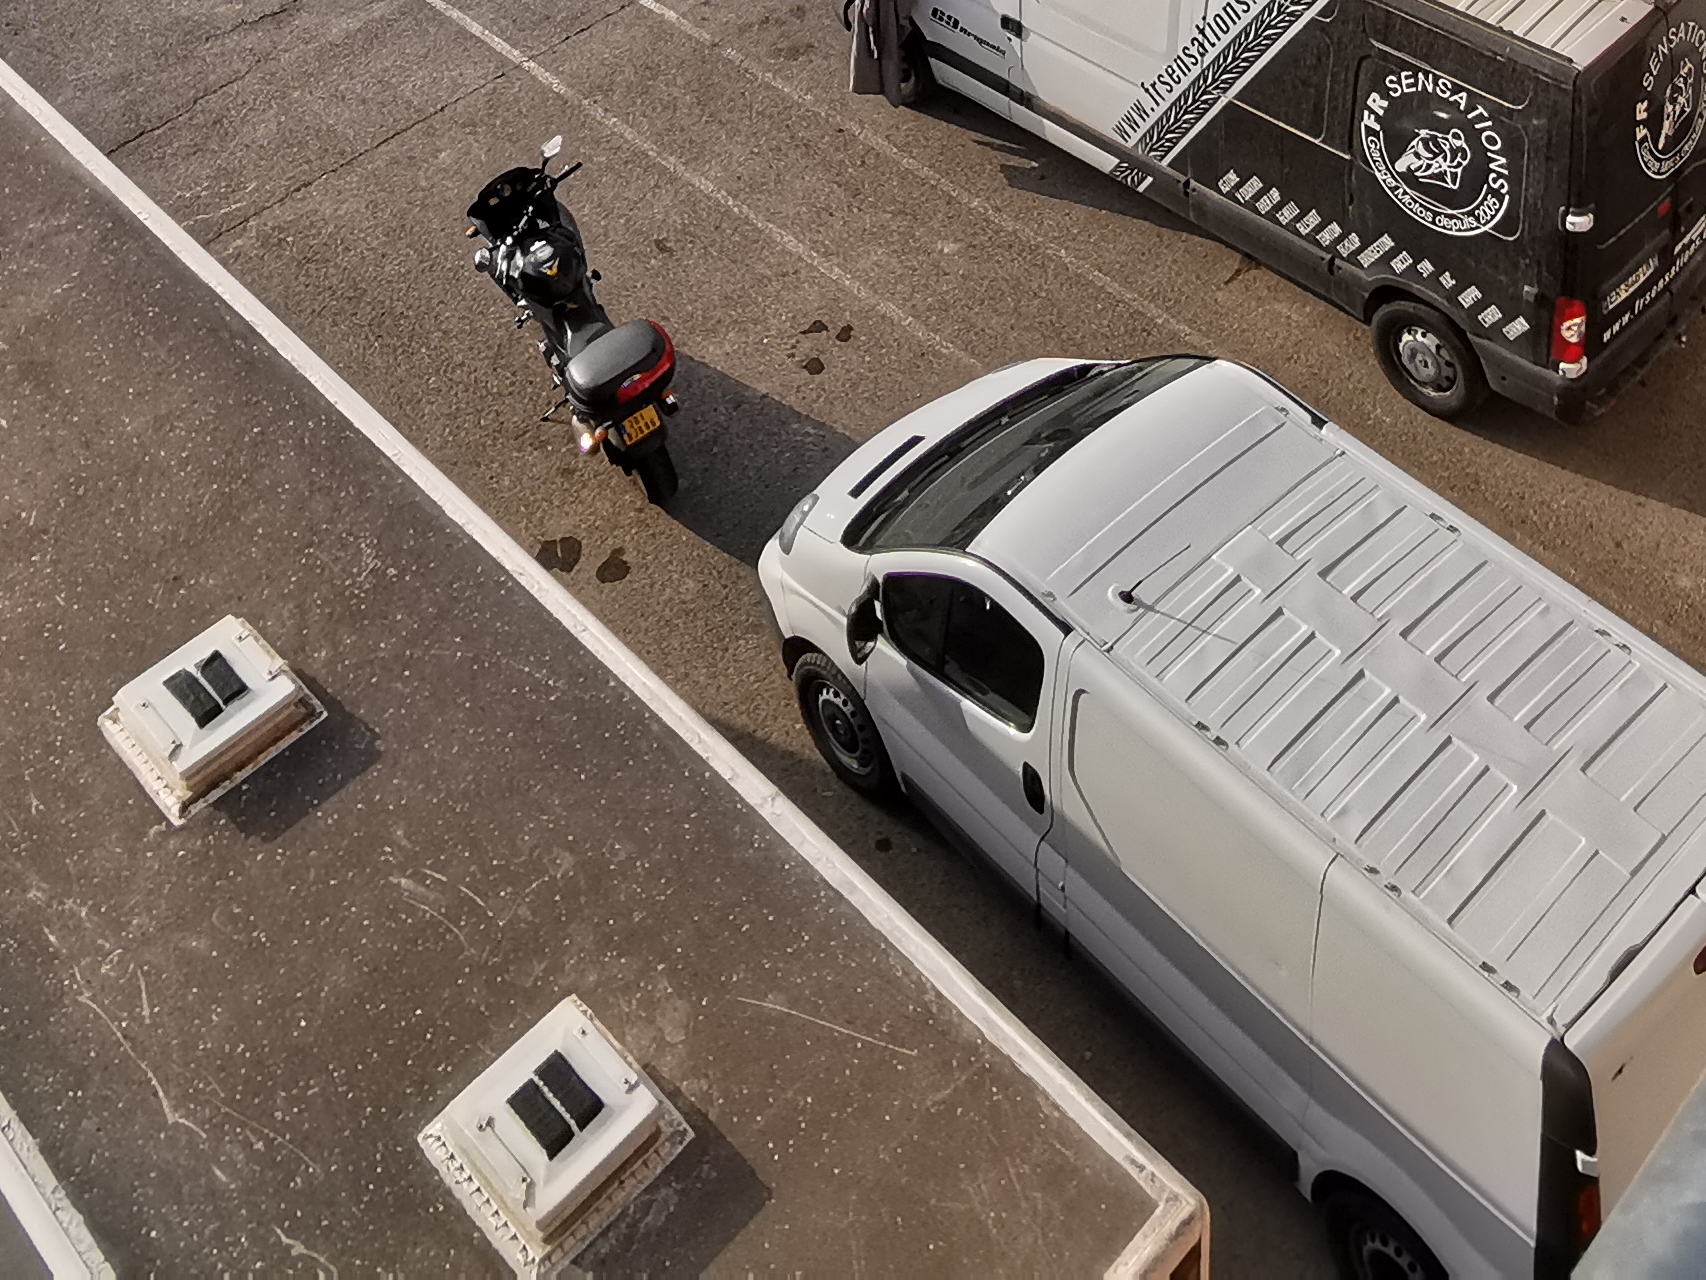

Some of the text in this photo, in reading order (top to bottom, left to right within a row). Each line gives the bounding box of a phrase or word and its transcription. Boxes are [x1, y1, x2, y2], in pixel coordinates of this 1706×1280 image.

[1363, 71, 1509, 194] FR SENSATIONS
[1635, 100, 1648, 141] FR
[1367, 136, 1500, 231] Garage Motos depuis 2005
[1416, 258, 1435, 279] SYM
[1438, 270, 1457, 290] HJC
